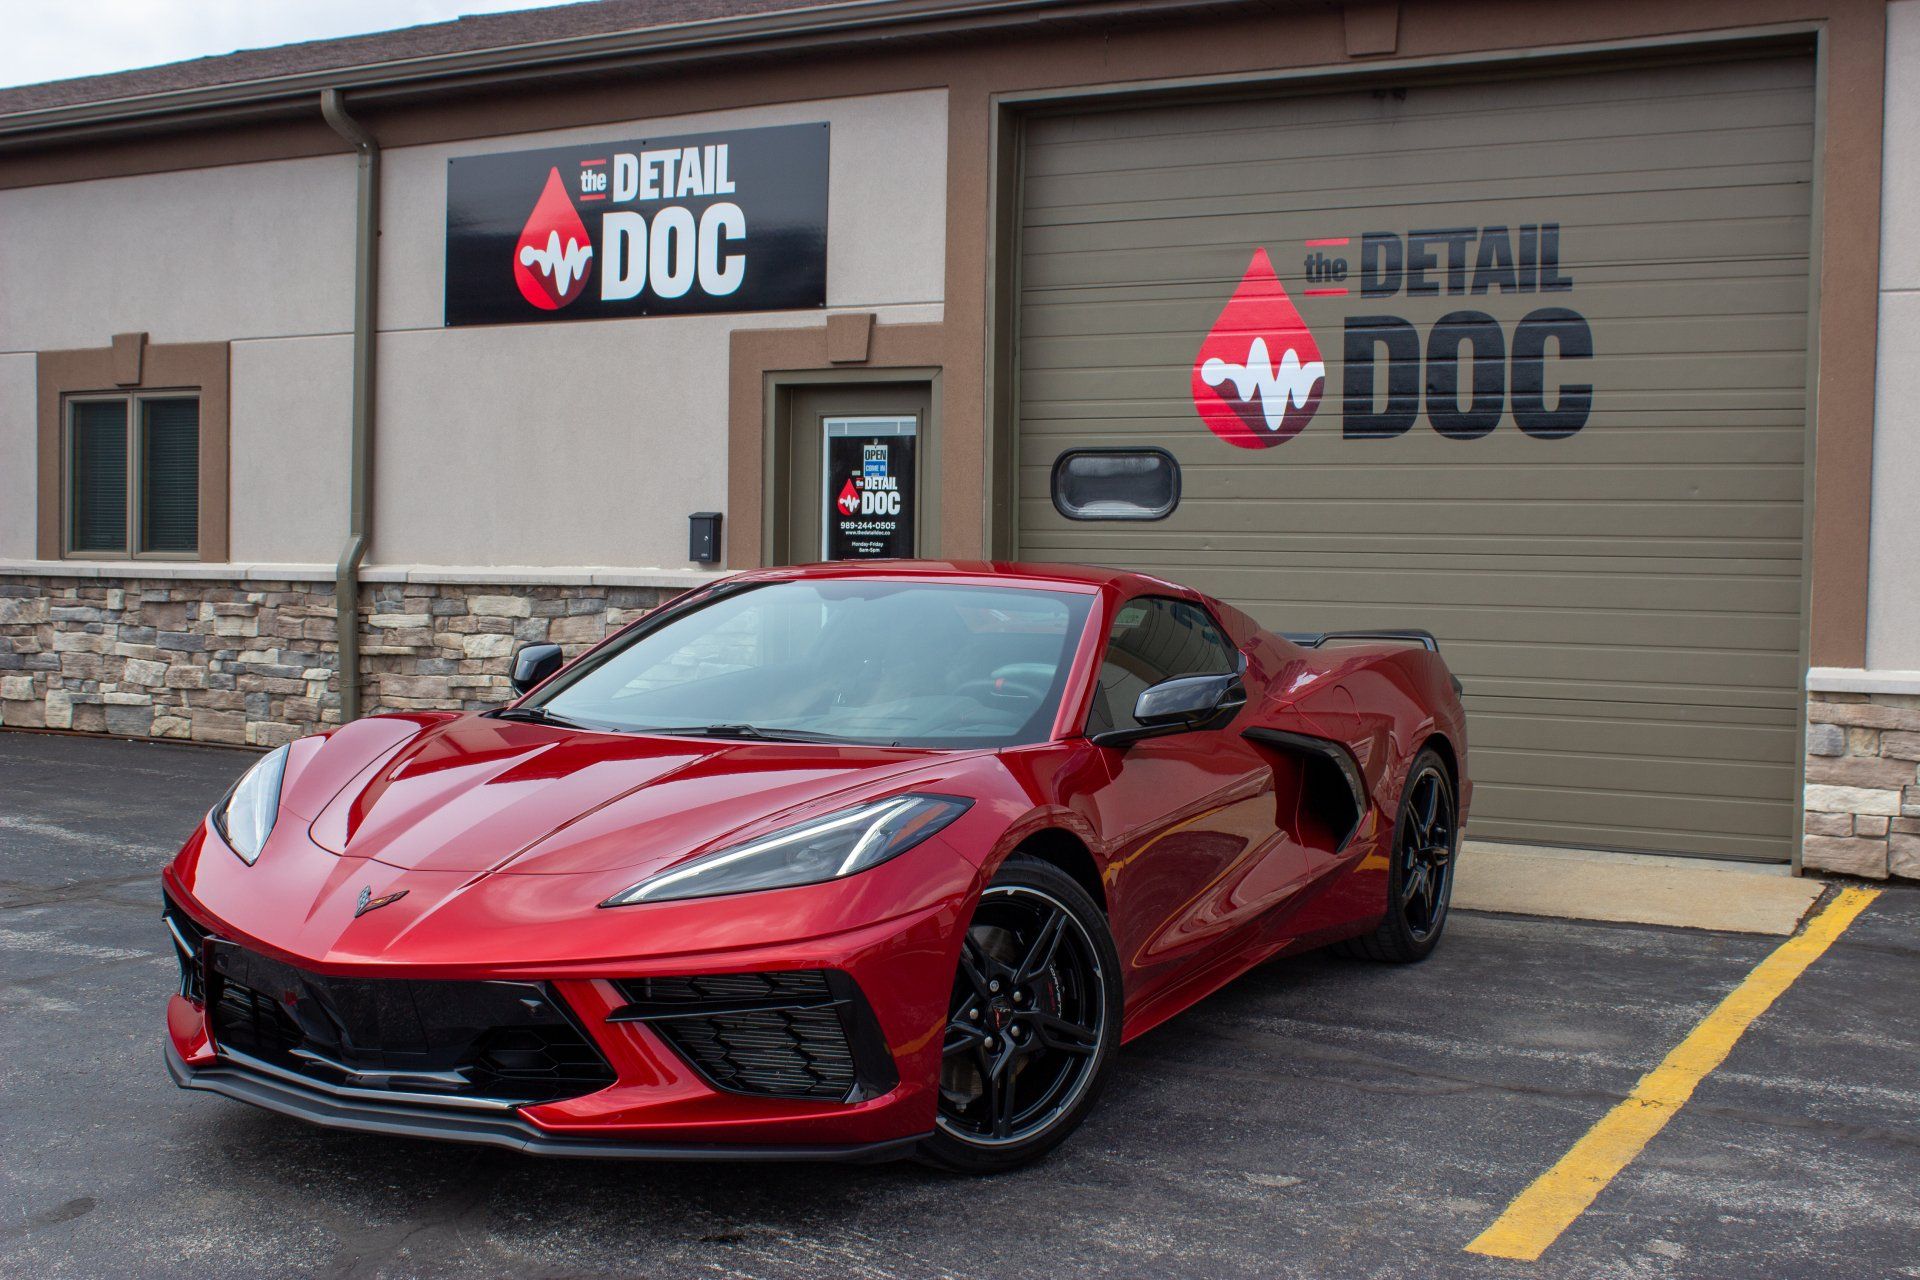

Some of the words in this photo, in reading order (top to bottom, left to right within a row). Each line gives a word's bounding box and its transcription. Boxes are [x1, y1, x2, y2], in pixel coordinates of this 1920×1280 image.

[580, 169, 607, 193] the
[613, 143, 736, 202] DETAIL
[601, 202, 746, 300] DOC
[1304, 251, 1348, 284] the
[1360, 223, 1573, 299] DETAIL
[1342, 307, 1593, 441] DOC
[865, 449, 887, 460] OPEN
[861, 491, 901, 515] DOC
[864, 476, 898, 490] DETAIL
[840, 521, 896, 530] 989-244-0505
